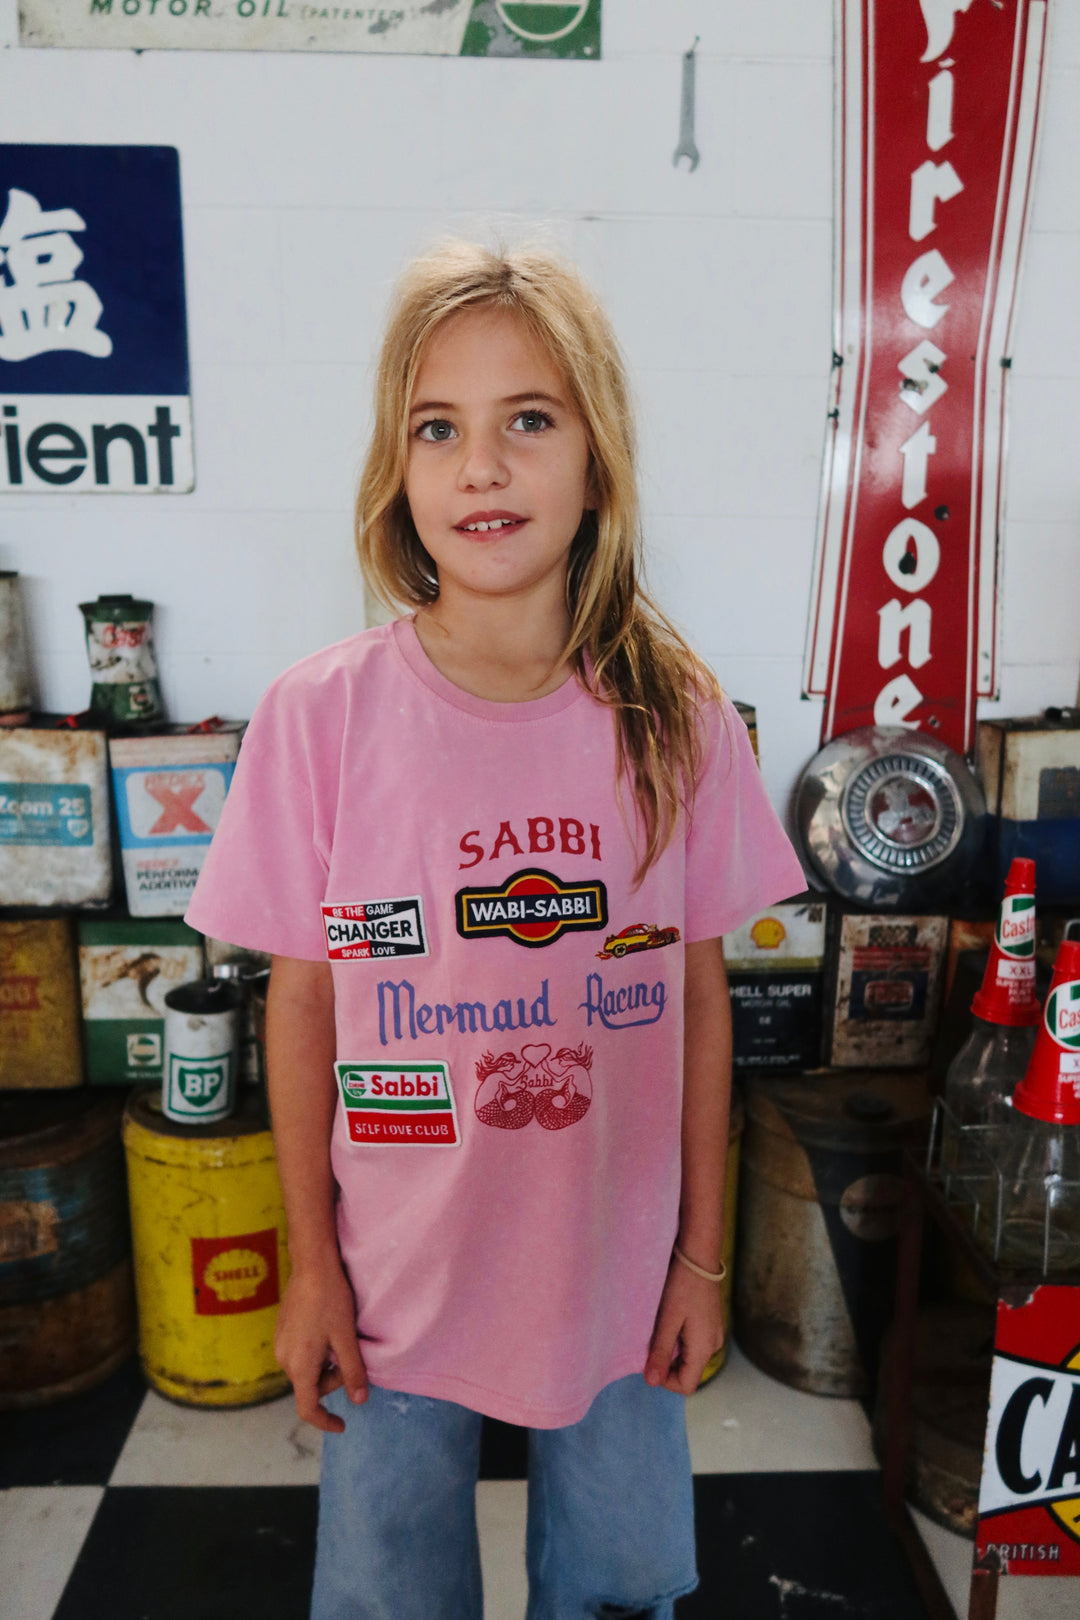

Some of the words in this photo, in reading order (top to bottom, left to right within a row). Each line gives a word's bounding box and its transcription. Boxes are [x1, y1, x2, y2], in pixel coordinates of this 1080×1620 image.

[89, 0, 211, 16] MOTOR
[236, 0, 287, 17] OIL
[0, 406, 181, 485] ient
[59, 796, 85, 816] 25
[458, 816, 602, 871] SABBI
[332, 907, 344, 918] BE
[345, 906, 364, 917] THE
[366, 903, 394, 916] GAME
[470, 895, 592, 923] WABI-SABBI
[327, 919, 413, 942] CHANGER
[341, 948, 370, 958] SPARK
[371, 946, 396, 956] LOVE
[767, 984, 812, 998] SUPER
[376, 978, 558, 1046] Mermaid
[577, 971, 668, 1030] Racing
[184, 1072, 220, 1097] BP
[371, 1074, 438, 1097] Sabbi
[515, 1073, 555, 1091] Sabbi
[355, 1122, 380, 1135] SELF
[383, 1123, 413, 1136] LOVE
[415, 1124, 449, 1136] CLUB
[212, 1266, 260, 1283] SHELL
